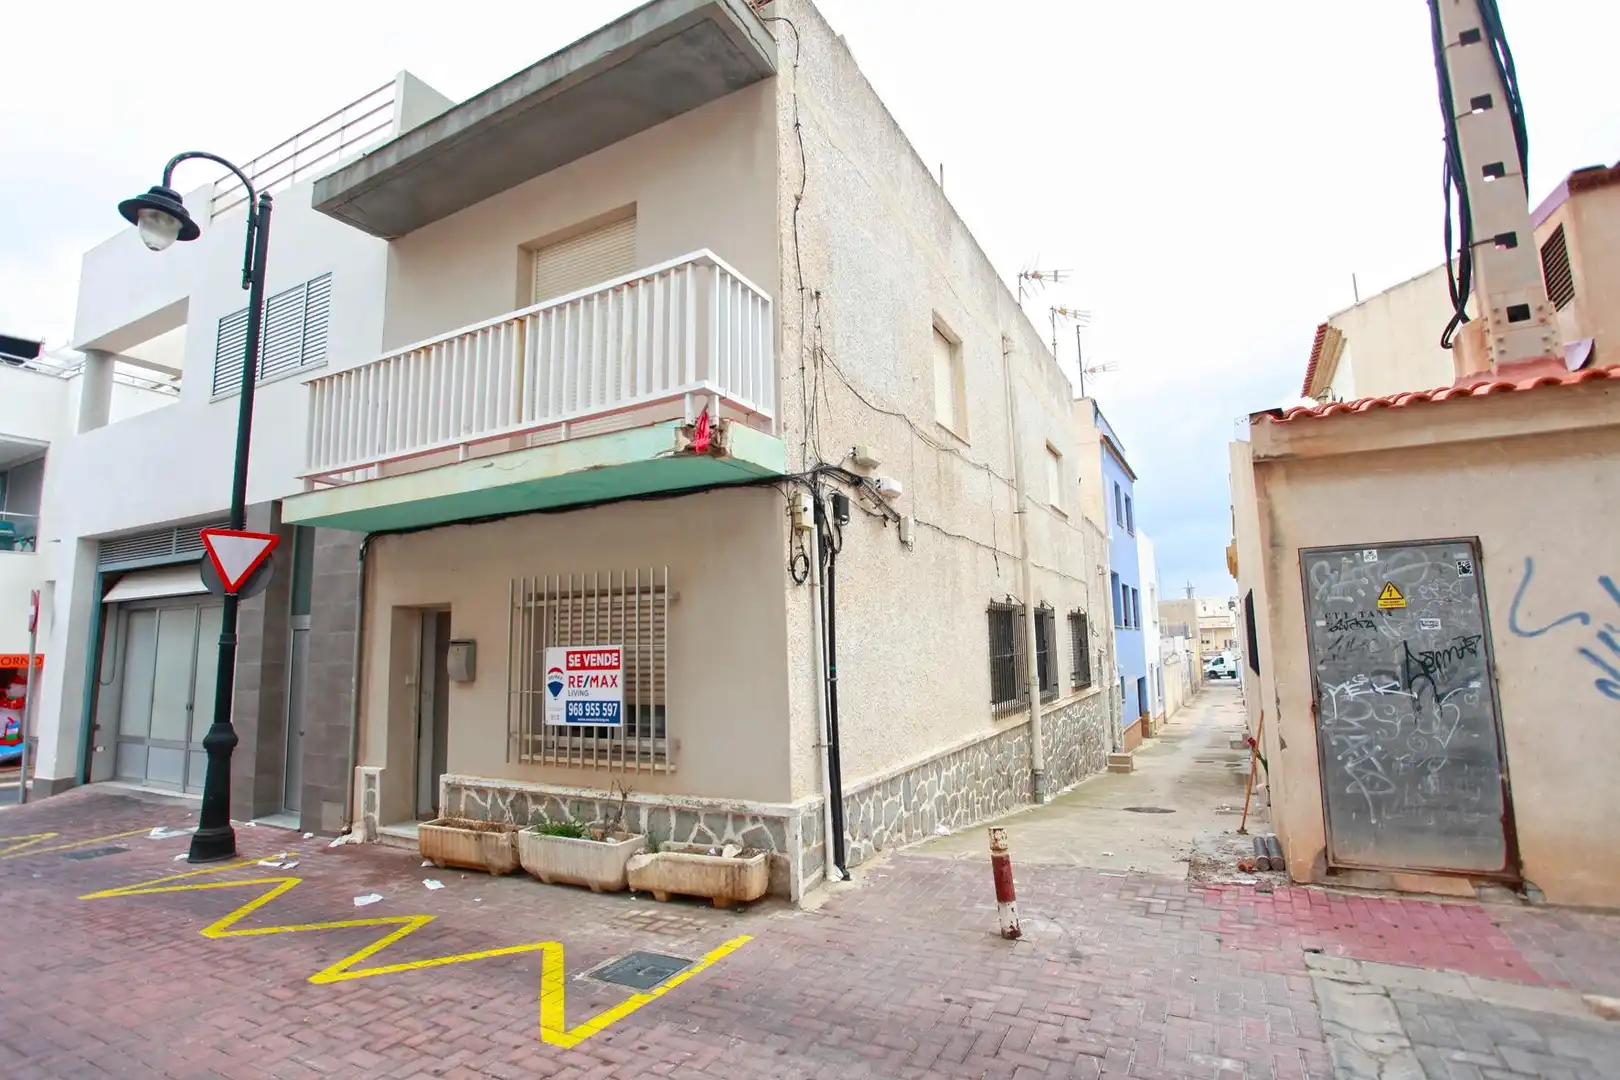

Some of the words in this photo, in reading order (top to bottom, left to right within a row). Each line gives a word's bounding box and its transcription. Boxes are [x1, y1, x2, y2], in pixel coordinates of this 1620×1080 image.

[568, 654, 581, 667] SE
[583, 653, 619, 666] VENDE
[568, 675, 618, 688] RE/MAX
[568, 702, 583, 716] 968
[585, 702, 600, 716] 955
[602, 702, 618, 717] 597
